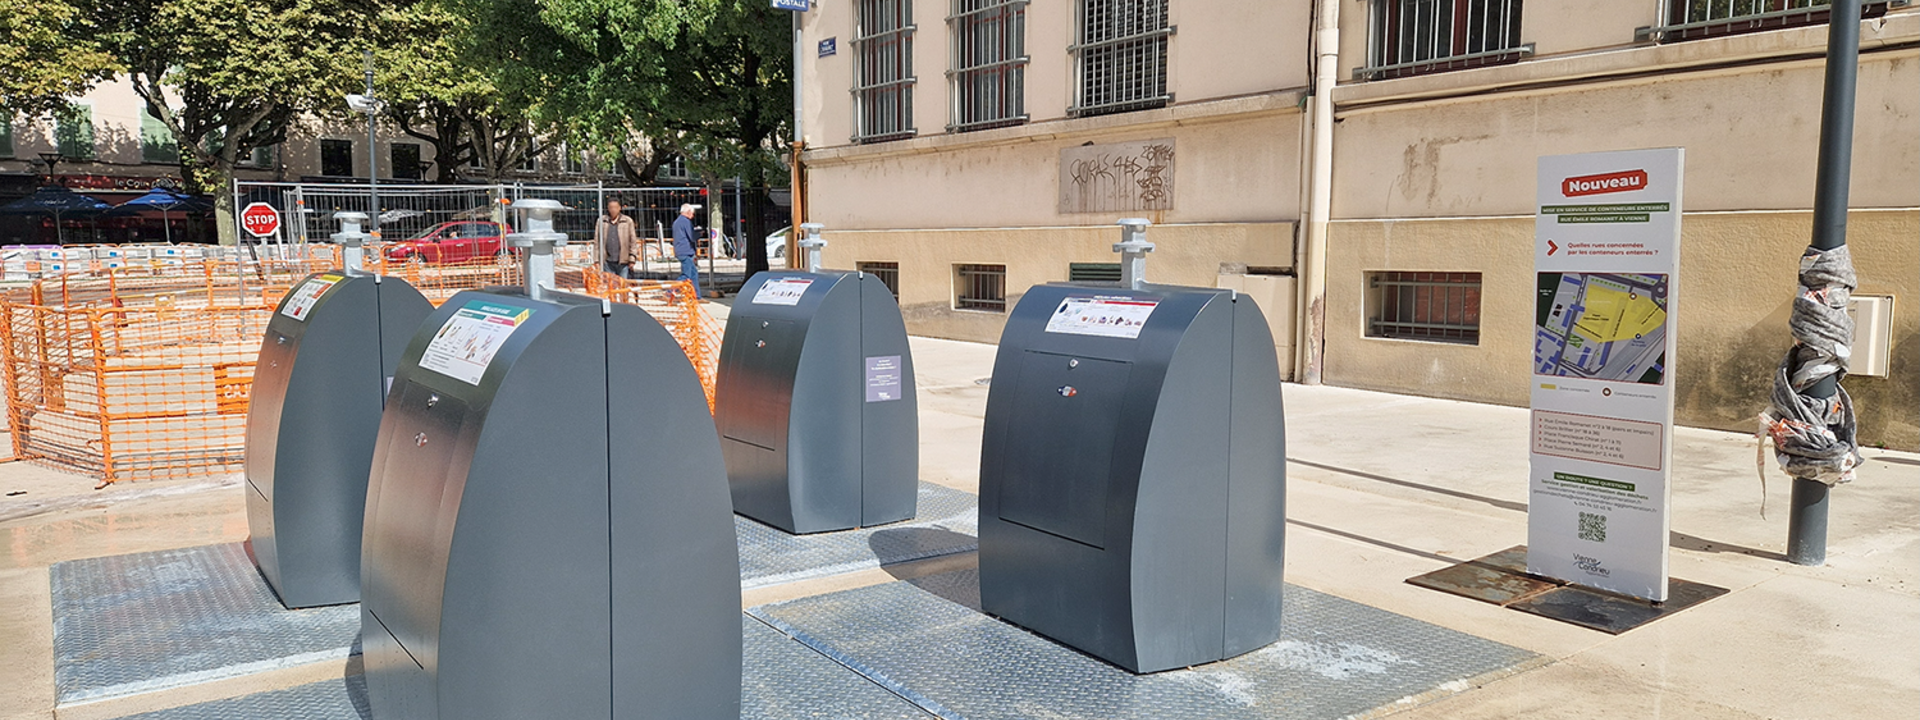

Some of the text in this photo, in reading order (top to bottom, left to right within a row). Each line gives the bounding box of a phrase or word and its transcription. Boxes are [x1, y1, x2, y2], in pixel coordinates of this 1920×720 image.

[1569, 176, 1640, 193] Nouveau
[246, 214, 276, 225] STOP
[1541, 478, 1559, 486] Service
[1586, 486, 1615, 494] valorisation
[1572, 552, 1597, 563] Vienne
[1577, 561, 1610, 576] Condrieu
